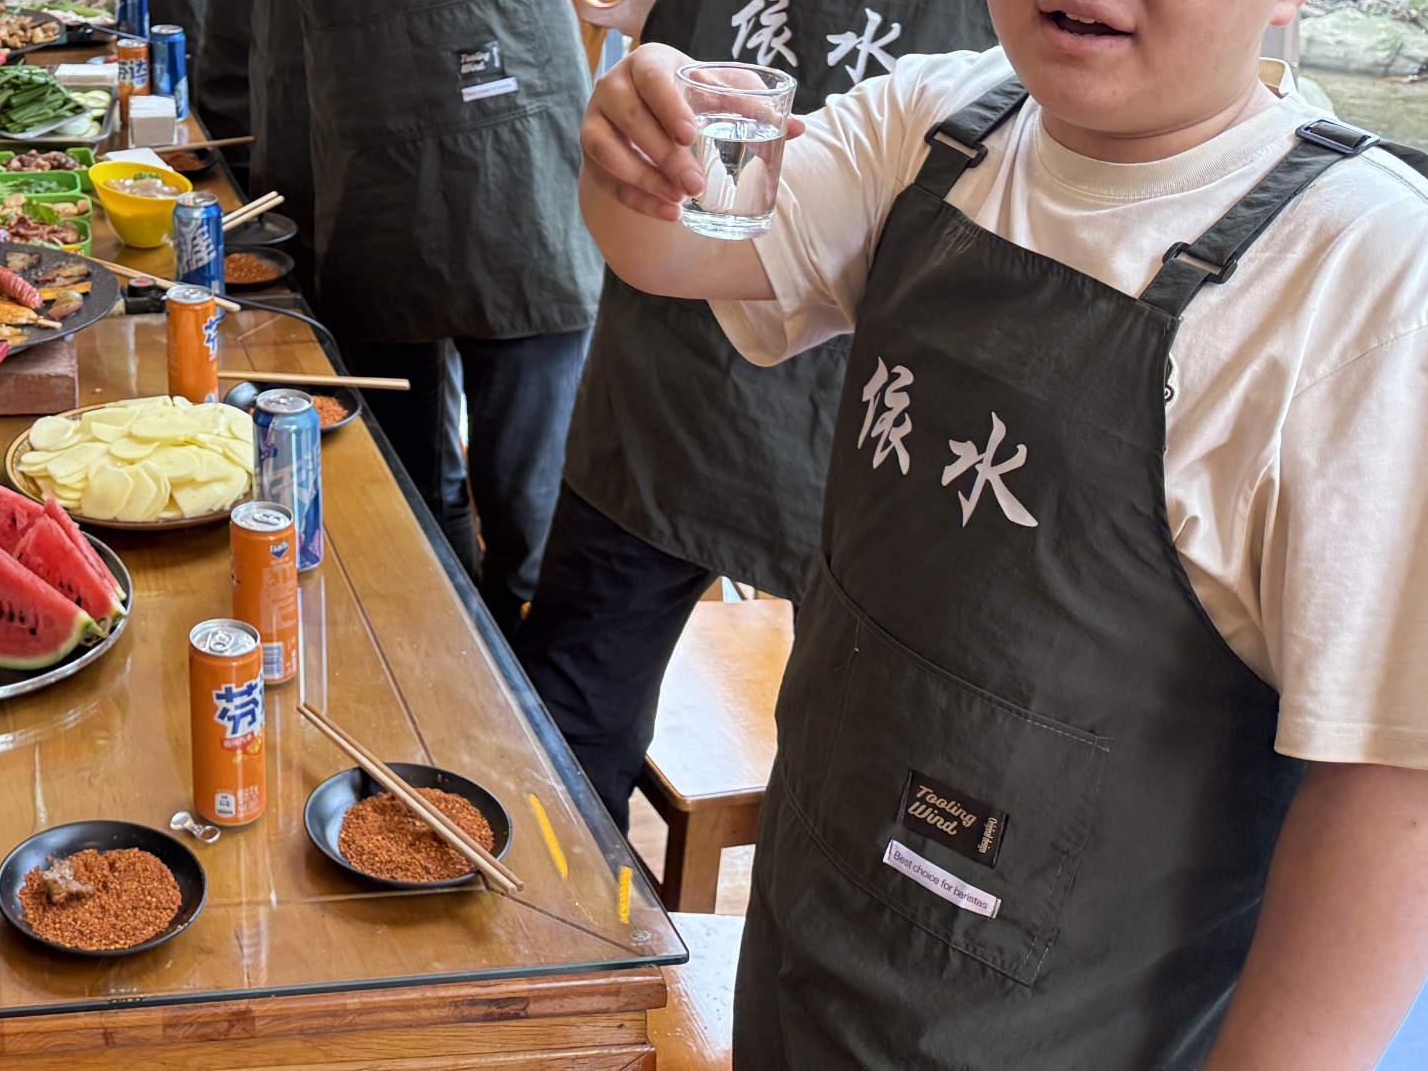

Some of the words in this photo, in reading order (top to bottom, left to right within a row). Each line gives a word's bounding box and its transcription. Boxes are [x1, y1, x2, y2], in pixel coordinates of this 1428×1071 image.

[857, 356, 1038, 529] 依水
[907, 801, 957, 836] Wind
[916, 785, 977, 827] Tooling
[893, 850, 913, 868] Best
[912, 863, 940, 885] choice
[940, 879, 953, 893] for
[953, 886, 988, 910] baristas
